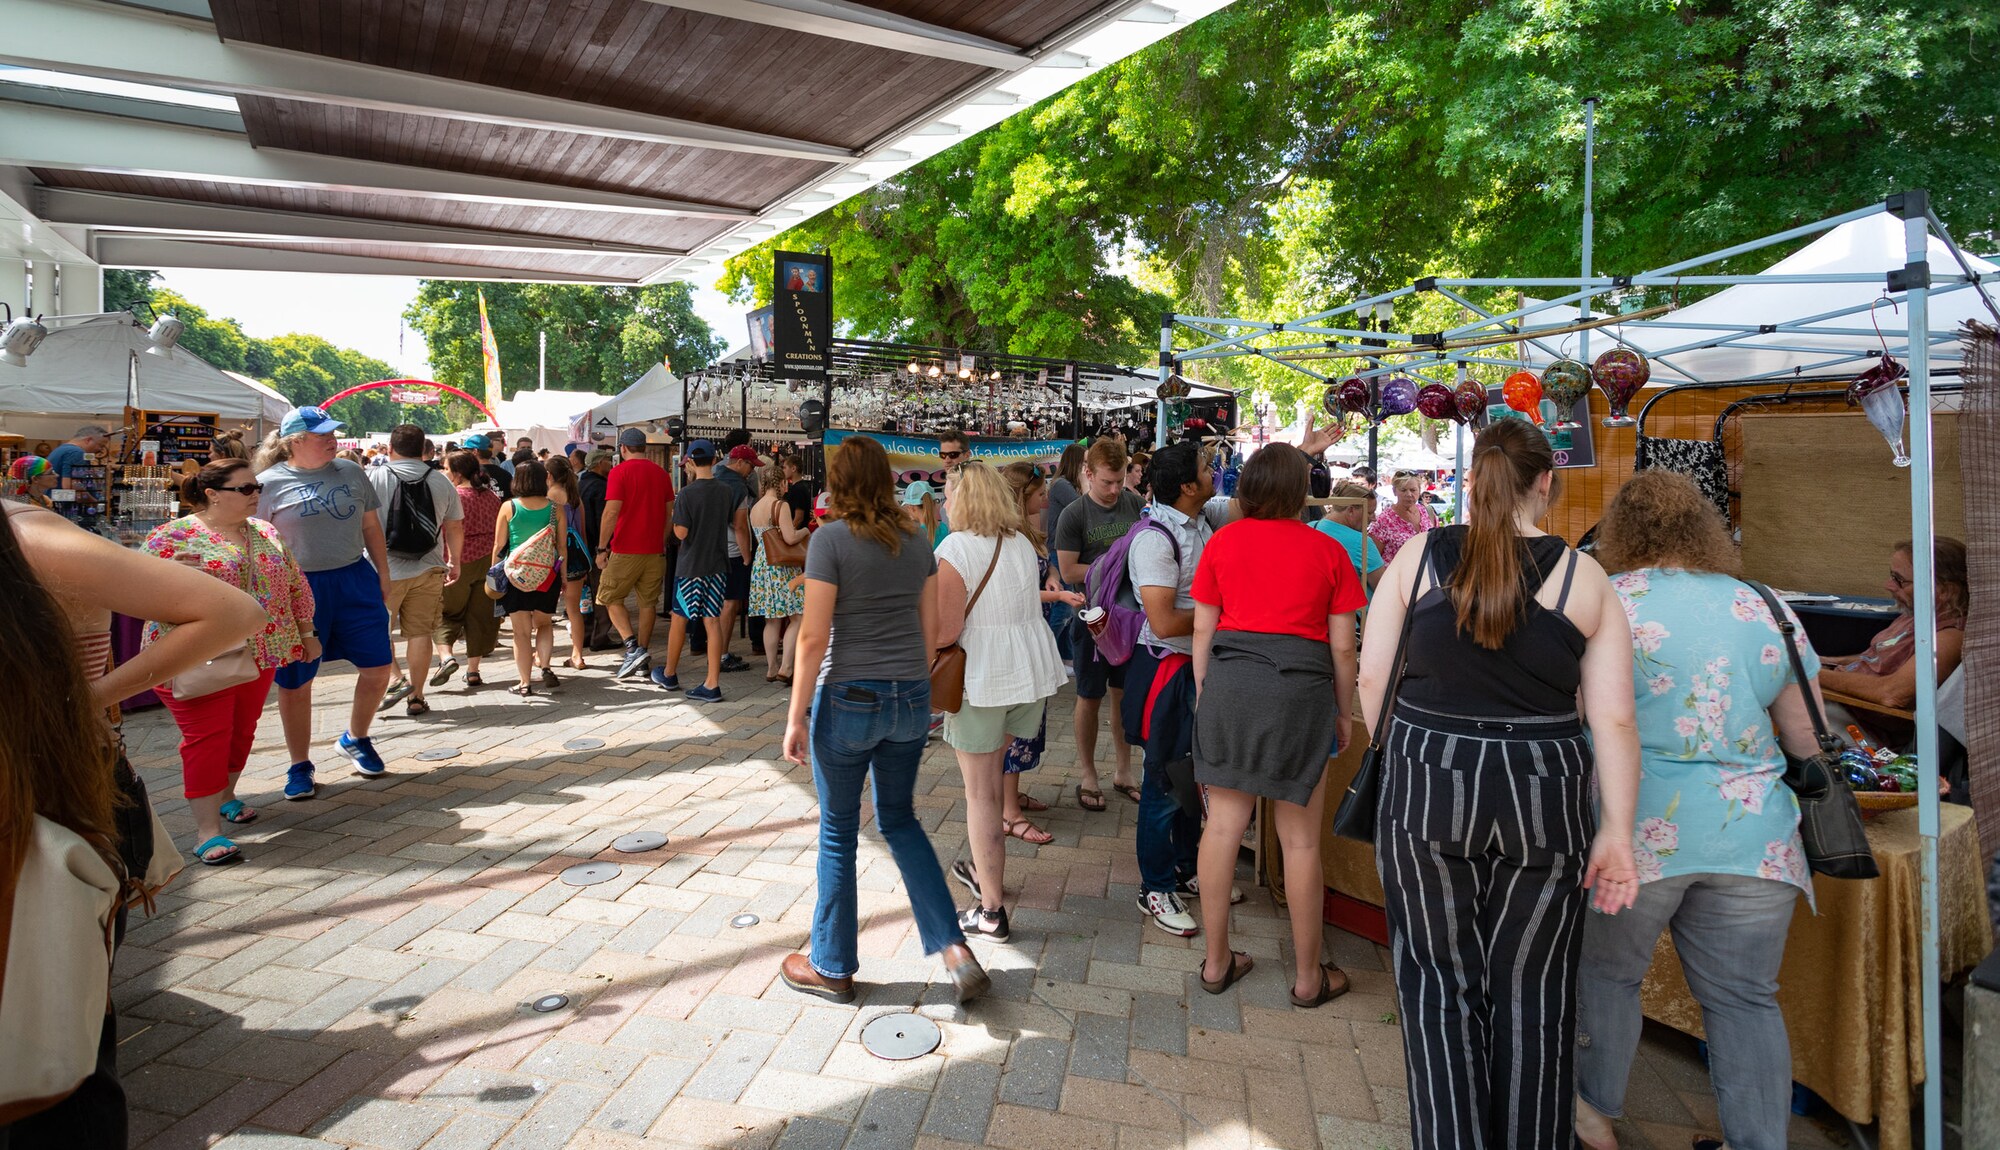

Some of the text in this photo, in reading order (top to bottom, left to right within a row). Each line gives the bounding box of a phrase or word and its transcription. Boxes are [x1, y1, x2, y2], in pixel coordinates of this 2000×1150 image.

[792, 293, 816, 351] SPOONMAN
[785, 353, 823, 361] CREATIONS
[783, 364, 824, 372] www.spoonman.com
[883, 440, 925, 457] ulous
[293, 480, 356, 521] KC
